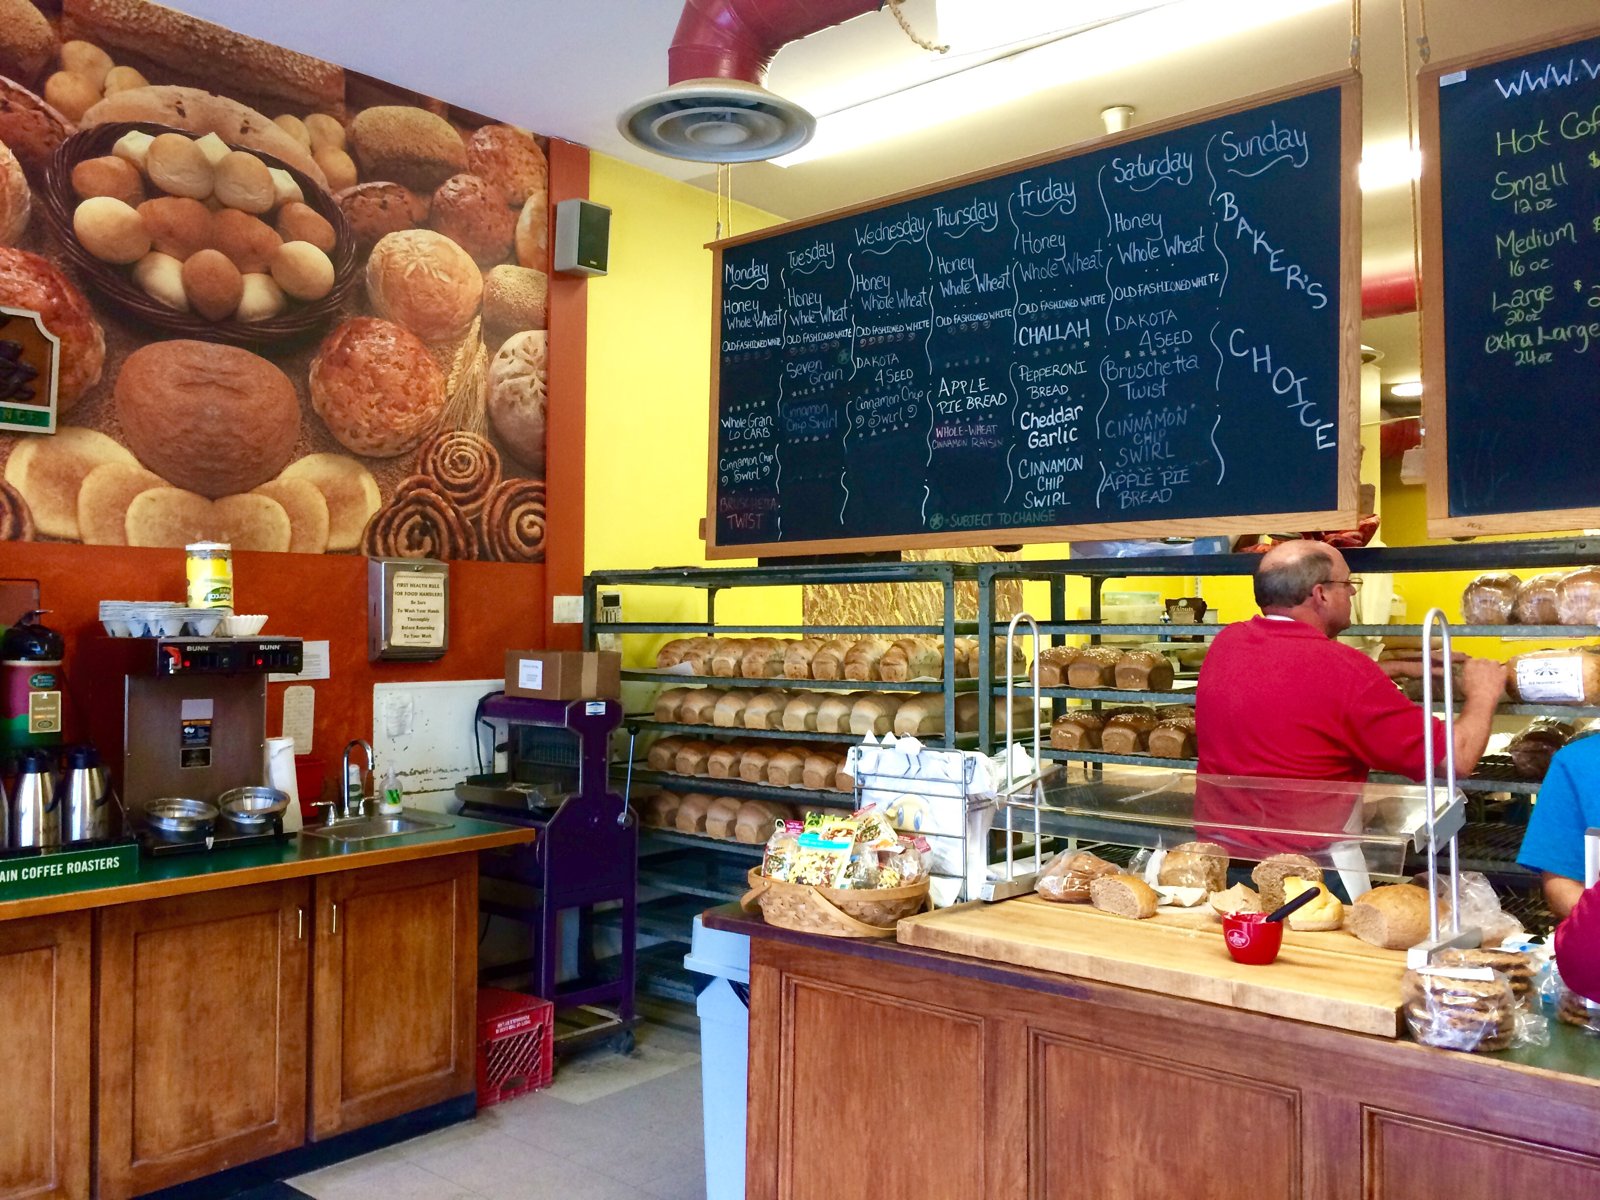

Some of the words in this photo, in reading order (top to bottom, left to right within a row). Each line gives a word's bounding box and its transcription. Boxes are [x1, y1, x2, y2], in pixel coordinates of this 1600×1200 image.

[1221, 120, 1308, 168] Sunday
[1496, 120, 1551, 156] Hot
[1112, 146, 1193, 186] Saturday
[1492, 162, 1568, 200] Small
[1018, 178, 1076, 214] Friday
[1514, 199, 1535, 214] 12
[933, 197, 998, 232] Thursday
[855, 212, 926, 246] Wednesday
[1115, 213, 1163, 240] Honey
[1022, 232, 1066, 260] Honey
[1117, 241, 1160, 264] Whole
[1164, 226, 1205, 257] Wheat
[1217, 191, 1327, 309] BAKER'S
[1496, 222, 1577, 259] Medium
[787, 241, 835, 269] Tuesday
[1020, 259, 1059, 282] Whole
[1062, 239, 1103, 275] Wheat
[725, 258, 769, 290] Monday
[937, 256, 976, 282] Honey
[1510, 260, 1525, 277] 16
[856, 274, 891, 298] Honey
[940, 278, 972, 298] Whole
[975, 265, 1010, 292] Wheat
[1114, 287, 1138, 300] OLD
[1138, 280, 1191, 296] FASHIONED
[788, 288, 822, 313] Honey
[861, 294, 894, 311] Whole
[896, 286, 927, 309] Wheat
[1018, 303, 1038, 316] OLD
[1040, 299, 1079, 311] FASHIONED
[1081, 294, 1106, 306] WHITE
[1493, 285, 1554, 314] Large
[1573, 279, 1582, 293] $
[724, 300, 759, 321] Honey
[727, 317, 752, 330] Whole
[753, 304, 782, 328] Wheat
[790, 310, 816, 326] Whole
[820, 299, 848, 323] Wheat
[935, 315, 952, 327] OLD
[954, 313, 989, 324] FASHIONED
[989, 308, 1012, 320] WHITE
[1115, 310, 1177, 331] DAKOTA
[1505, 310, 1524, 326] 20
[1526, 313, 1541, 322] oz
[787, 335, 801, 345] OLD
[856, 327, 871, 338] OLD
[871, 324, 904, 335] FASHIONED
[905, 319, 930, 331] WHITE
[1019, 318, 1090, 346] CHALLAH
[1538, 323, 1600, 353] Large
[722, 341, 736, 352] OLD
[1139, 330, 1152, 351] 4
[1155, 330, 1192, 348] SEED
[787, 360, 822, 378] Seven
[856, 353, 899, 369] DAKOTA
[1105, 355, 1199, 380] Bruschetta
[1515, 350, 1536, 366] 24
[1538, 352, 1553, 364] oz
[809, 368, 843, 385] Grain
[875, 369, 884, 386] 4
[886, 368, 913, 383] SEED
[1019, 360, 1087, 382] PEPPERONI
[855, 395, 900, 411] Cinnamon
[902, 386, 923, 402] Chip
[938, 377, 990, 397] APPLE
[1026, 385, 1069, 399] BREAD
[1119, 378, 1168, 400] Twist
[1230, 328, 1336, 449] CHOICE
[937, 399, 963, 415] PIE
[966, 393, 1007, 410] BREAD
[721, 416, 746, 429] Whole
[748, 412, 774, 428] Grain
[1020, 405, 1083, 430] Cheddar
[1105, 410, 1187, 439] CINNAMON
[744, 427, 770, 439] CARB
[936, 424, 998, 438] WHOLE-WHEAT
[1028, 427, 1078, 449] Garlic
[1133, 429, 1166, 445] CHIP
[720, 456, 758, 471] Cinnamon
[1116, 442, 1175, 467] SWIRL
[734, 467, 761, 483] Swirl
[1018, 455, 1083, 479] CINNAMON
[1037, 474, 1064, 491] CHIP
[1102, 472, 1153, 493] APPLE
[1160, 469, 1190, 486] PIE
[1023, 491, 1071, 508] SWIRL
[1117, 488, 1172, 509] BREAD
[727, 513, 764, 529] TWIST
[950, 513, 993, 527] SUBJECT
[1000, 513, 1011, 524] TO
[1012, 509, 1055, 525] CHANGE
[22, 863, 63, 880] COFFEE
[66, 856, 120, 874] ROASTERS
